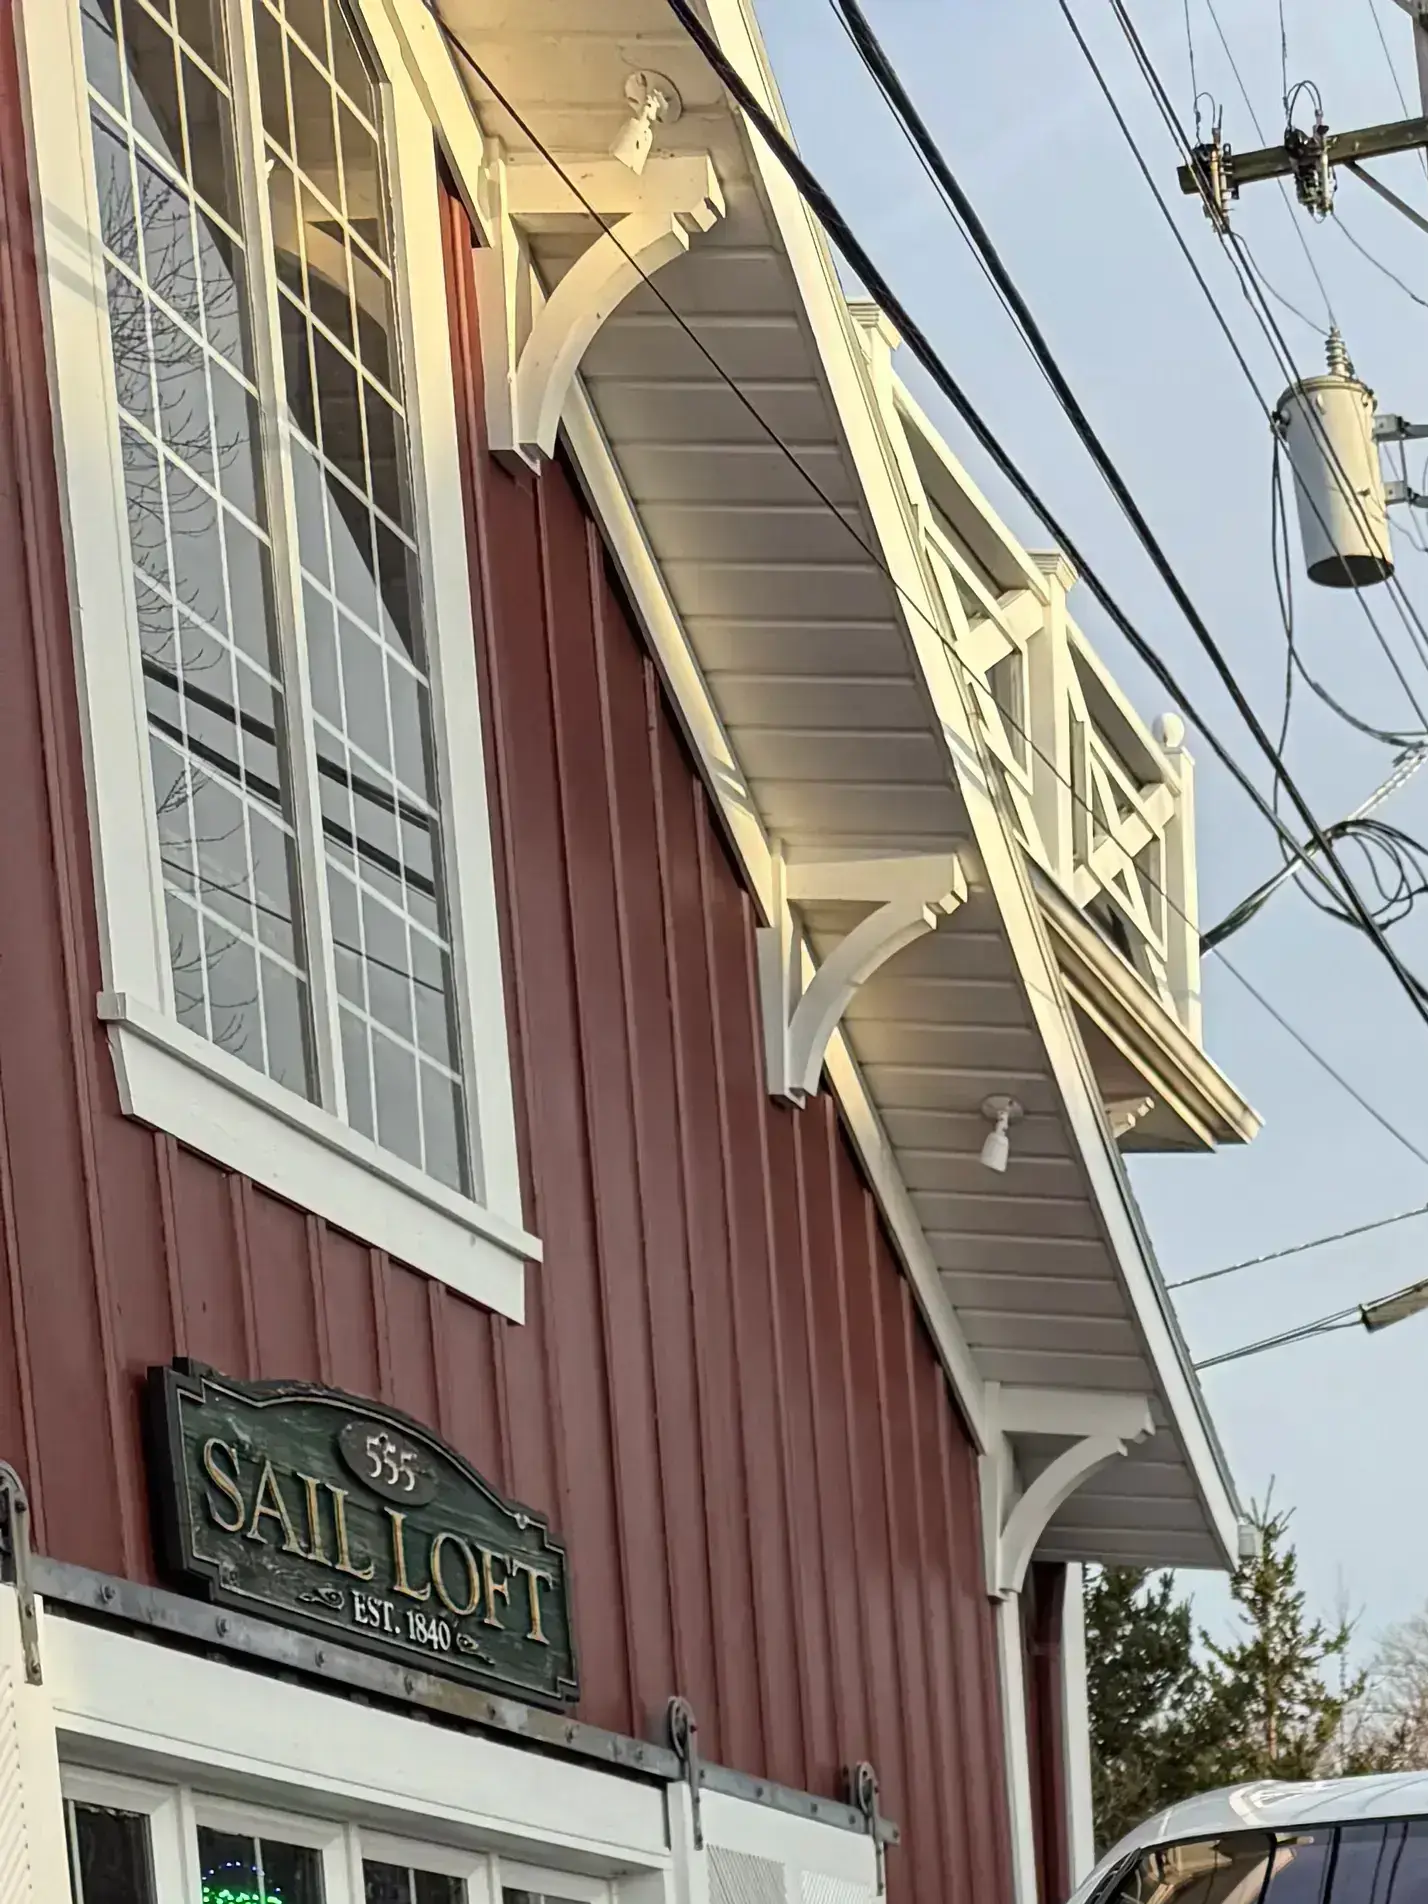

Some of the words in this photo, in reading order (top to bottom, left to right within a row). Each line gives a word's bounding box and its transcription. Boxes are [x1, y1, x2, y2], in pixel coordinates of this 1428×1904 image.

[365, 1431, 418, 1492] 555
[203, 1437, 375, 1581] SAIL
[384, 1506, 554, 1646] LOFT
[351, 1589, 401, 1635] EST.
[406, 1610, 452, 1652] 1840
